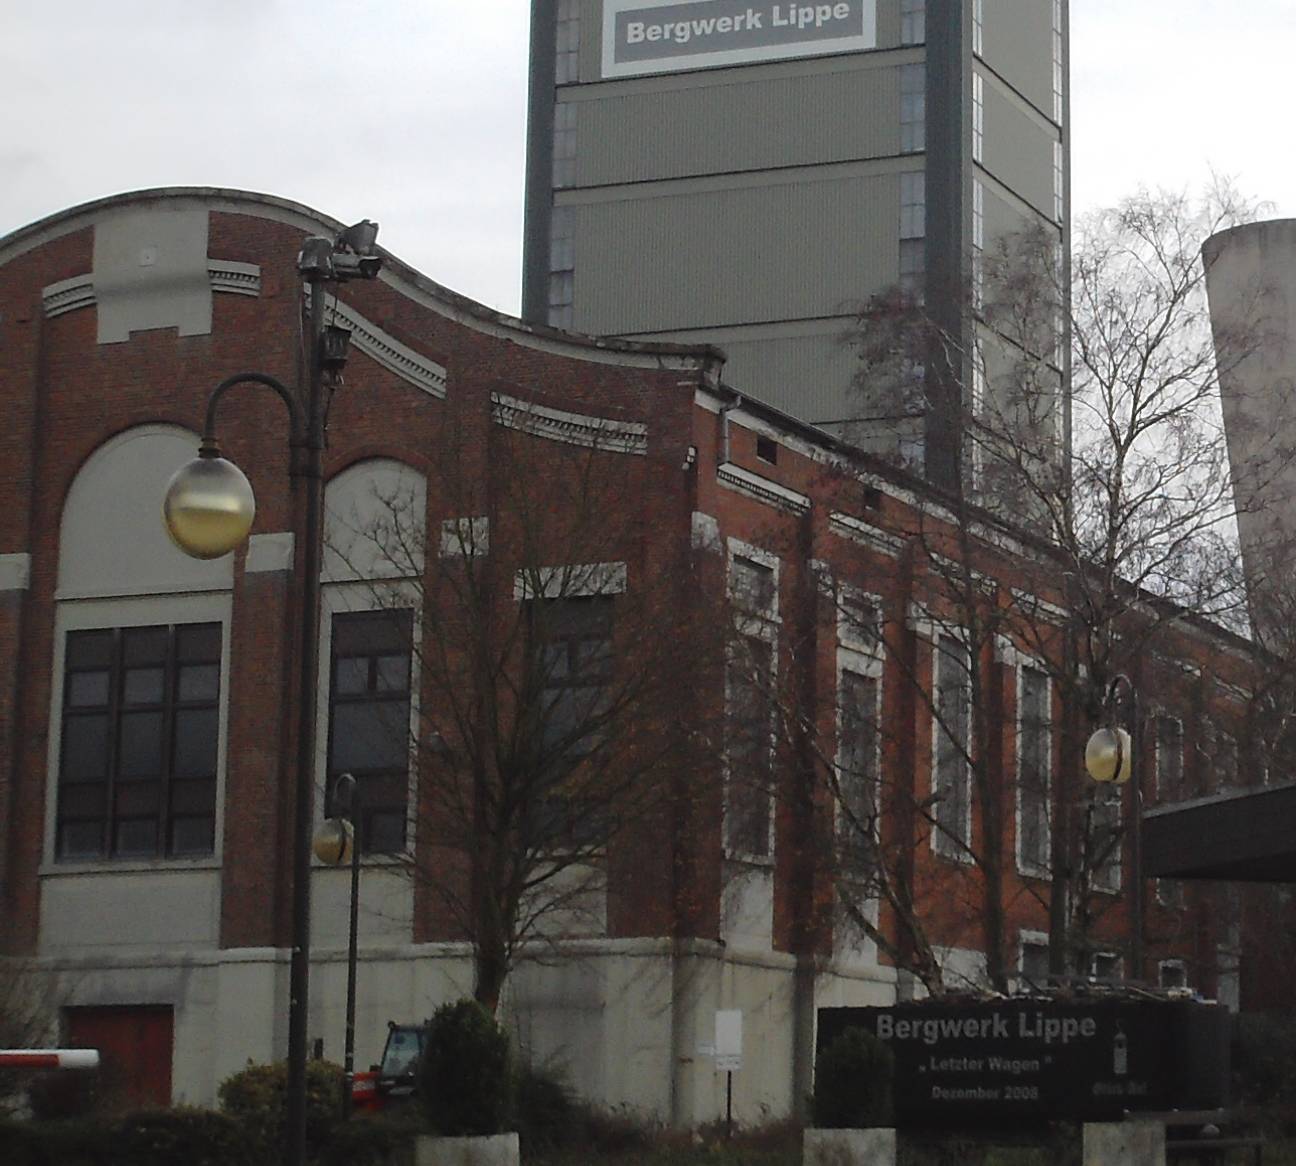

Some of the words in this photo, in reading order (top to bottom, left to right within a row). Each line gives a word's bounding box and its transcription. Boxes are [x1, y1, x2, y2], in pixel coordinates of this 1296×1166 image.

[627, 9, 762, 44] Bergwerk
[772, 2, 850, 28] Lippe
[876, 1012, 1009, 1045] Bergwerk
[1018, 1012, 1096, 1043] Lippe
[932, 1086, 1000, 1100] Dezember
[1004, 1086, 1038, 1100] 2008
